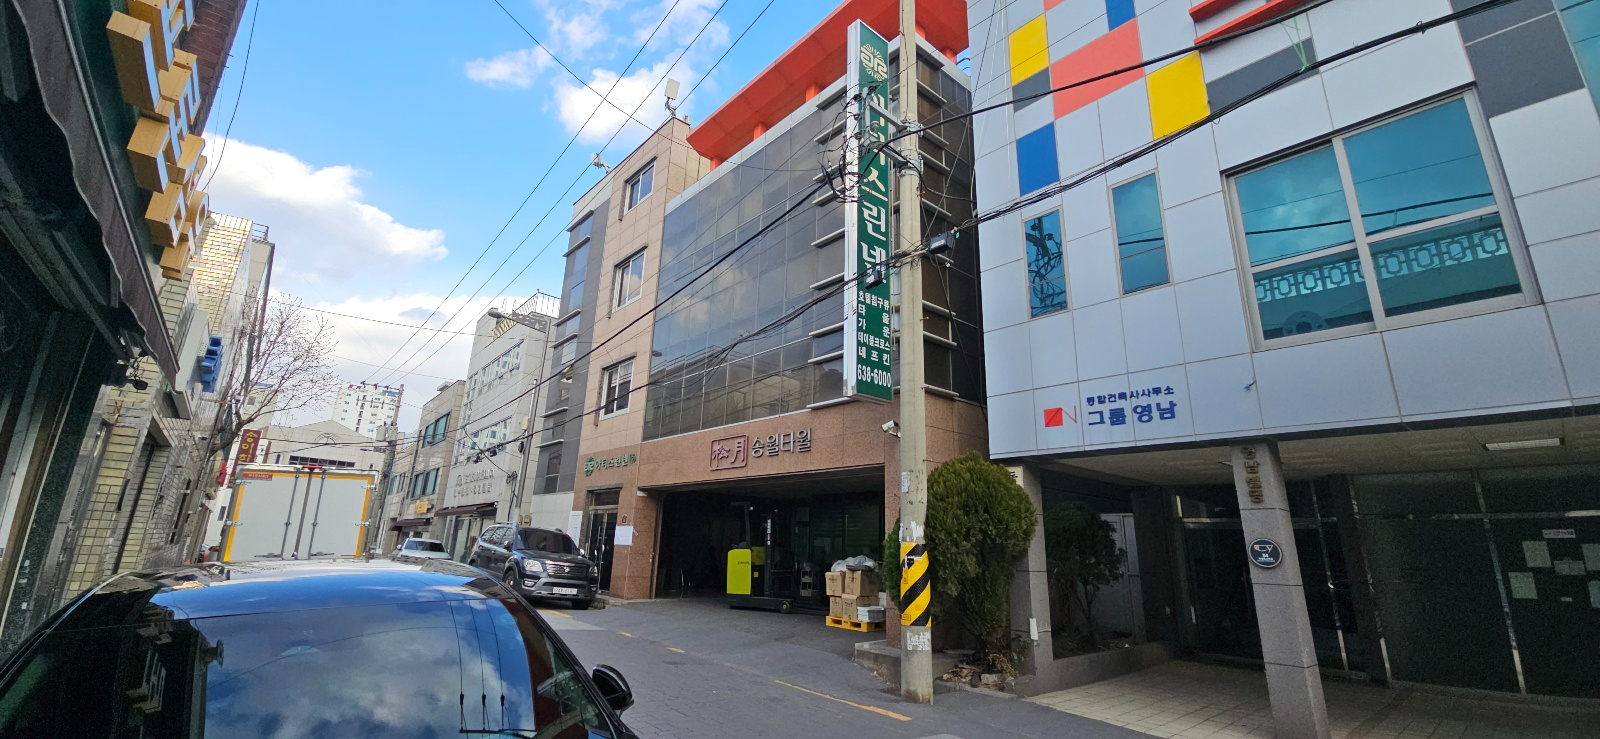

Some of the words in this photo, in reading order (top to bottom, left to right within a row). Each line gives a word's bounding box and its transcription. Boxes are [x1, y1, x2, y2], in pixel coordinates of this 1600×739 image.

[858, 290, 890, 312] 호텔침구류
[858, 331, 891, 351] 테이블크로스
[857, 363, 892, 388] 638-6000
[1086, 385, 1175, 406] 통합건축사사무소
[1088, 407, 1127, 426] 그룹
[1132, 400, 1177, 424] 영남
[711, 438, 747, 468] 松月
[751, 427, 812, 458] 송월타월
[1241, 445, 1264, 504] 영남빌딩
